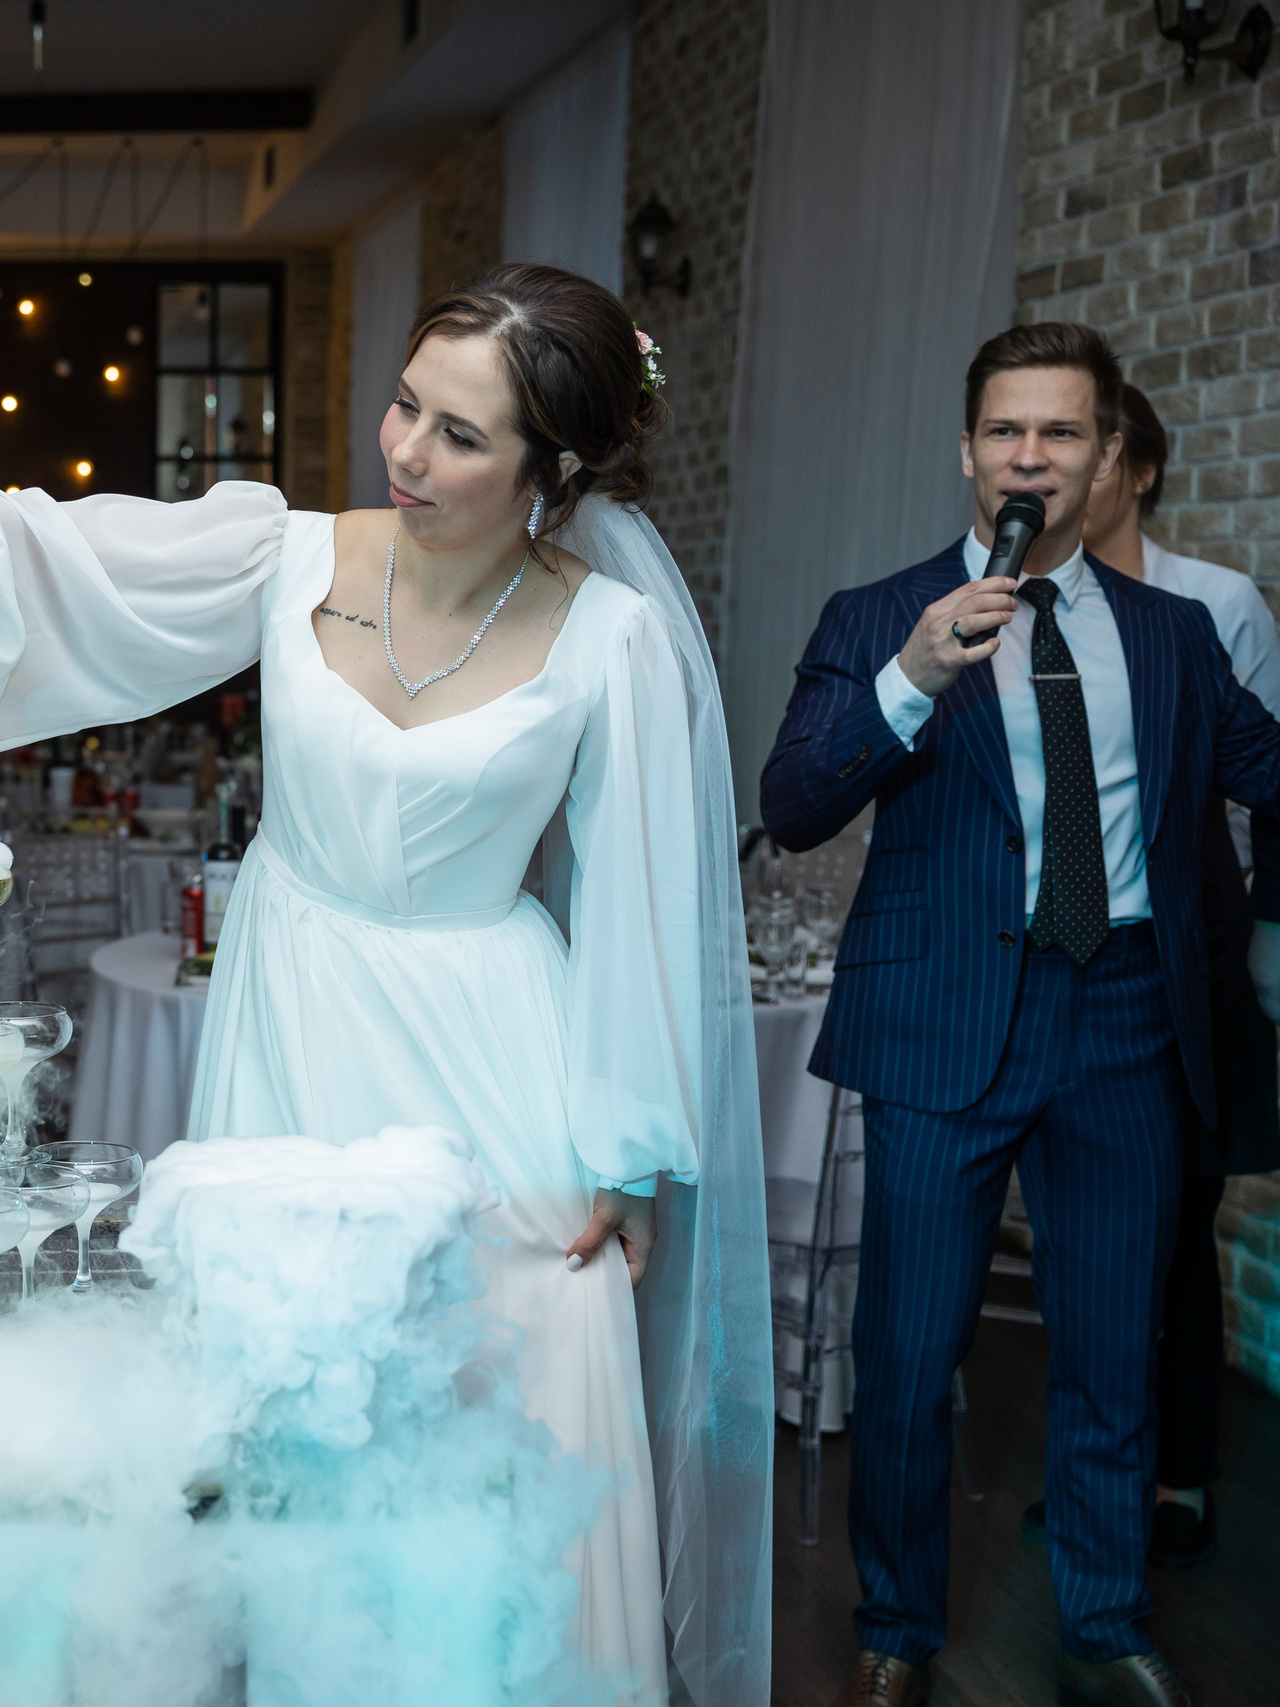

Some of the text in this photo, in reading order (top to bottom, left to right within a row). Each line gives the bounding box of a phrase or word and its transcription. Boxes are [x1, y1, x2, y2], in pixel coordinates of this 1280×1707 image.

[319, 607, 377, 630] aspera ad astra
